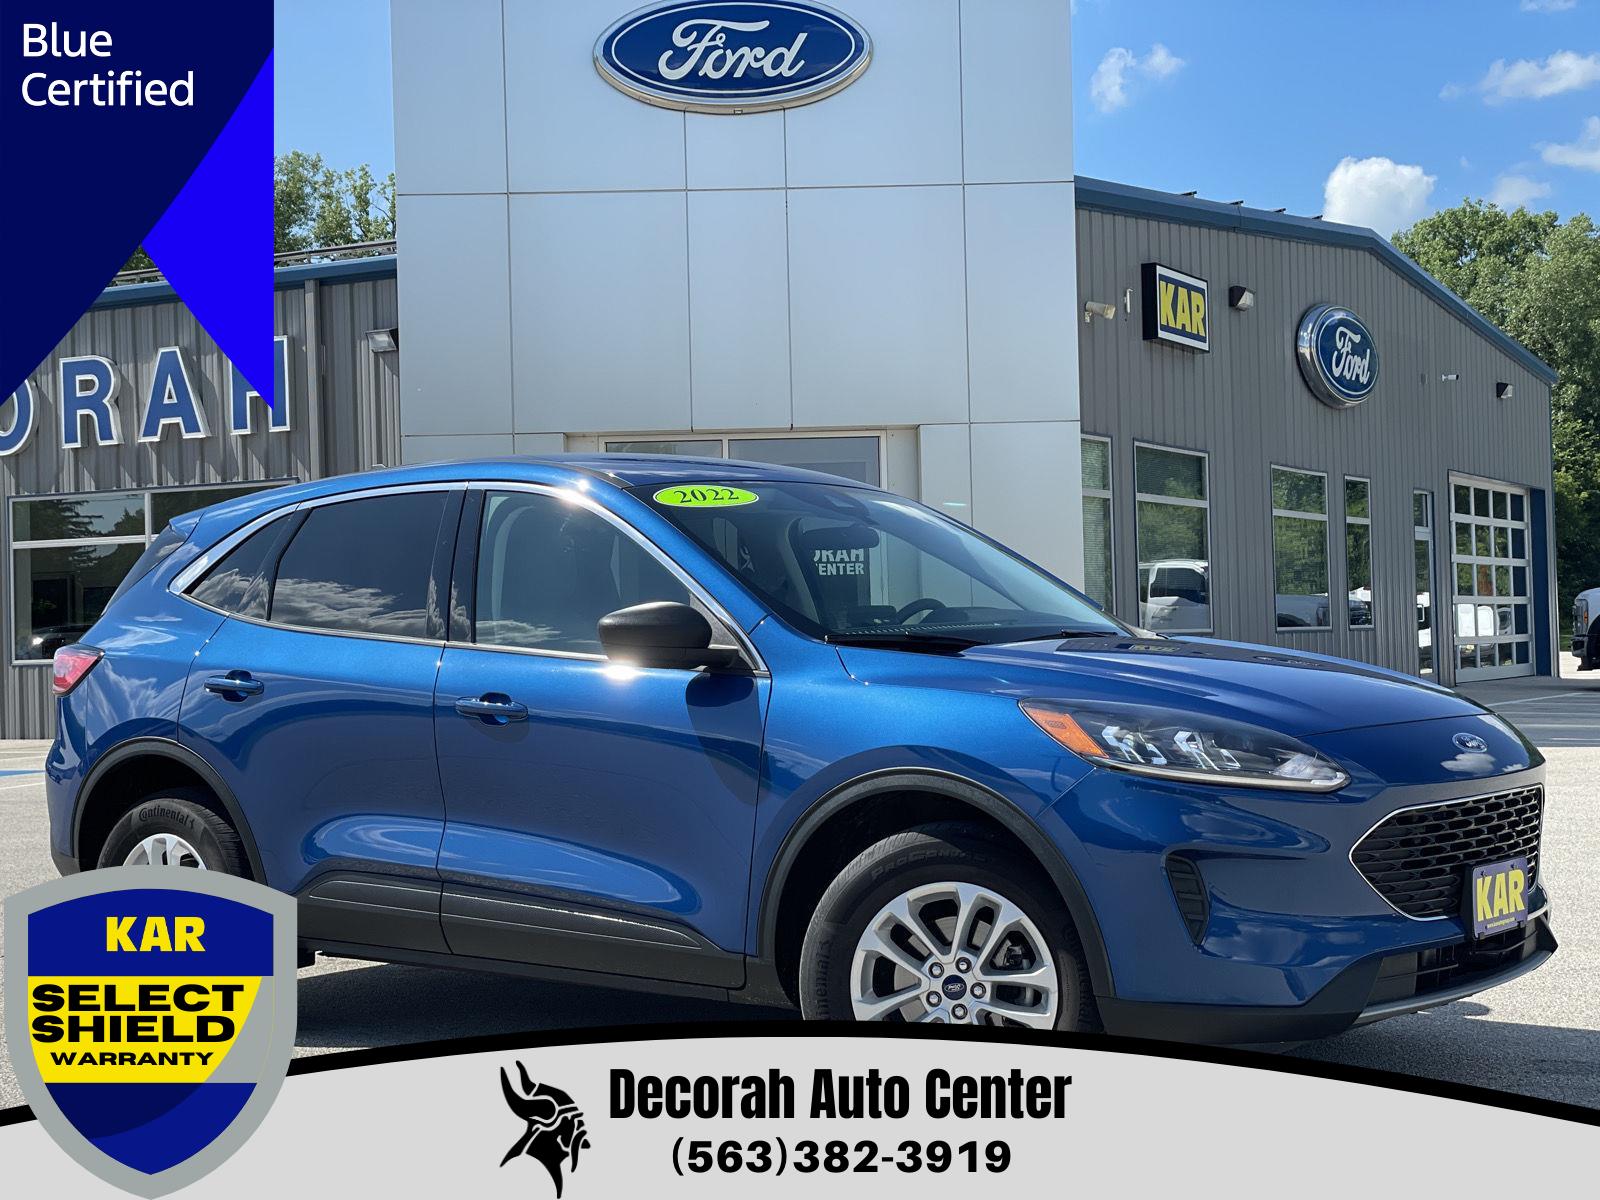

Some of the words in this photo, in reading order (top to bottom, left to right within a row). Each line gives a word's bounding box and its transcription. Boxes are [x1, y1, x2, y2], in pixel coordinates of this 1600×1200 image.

[657, 18, 808, 80] Ford
[1159, 280, 1206, 337] KAR
[1331, 326, 1371, 385] Ford
[673, 488, 740, 504] 2022
[815, 563, 865, 576] ENTER
[139, 805, 189, 827] Continental
[1476, 869, 1525, 922] KAR
